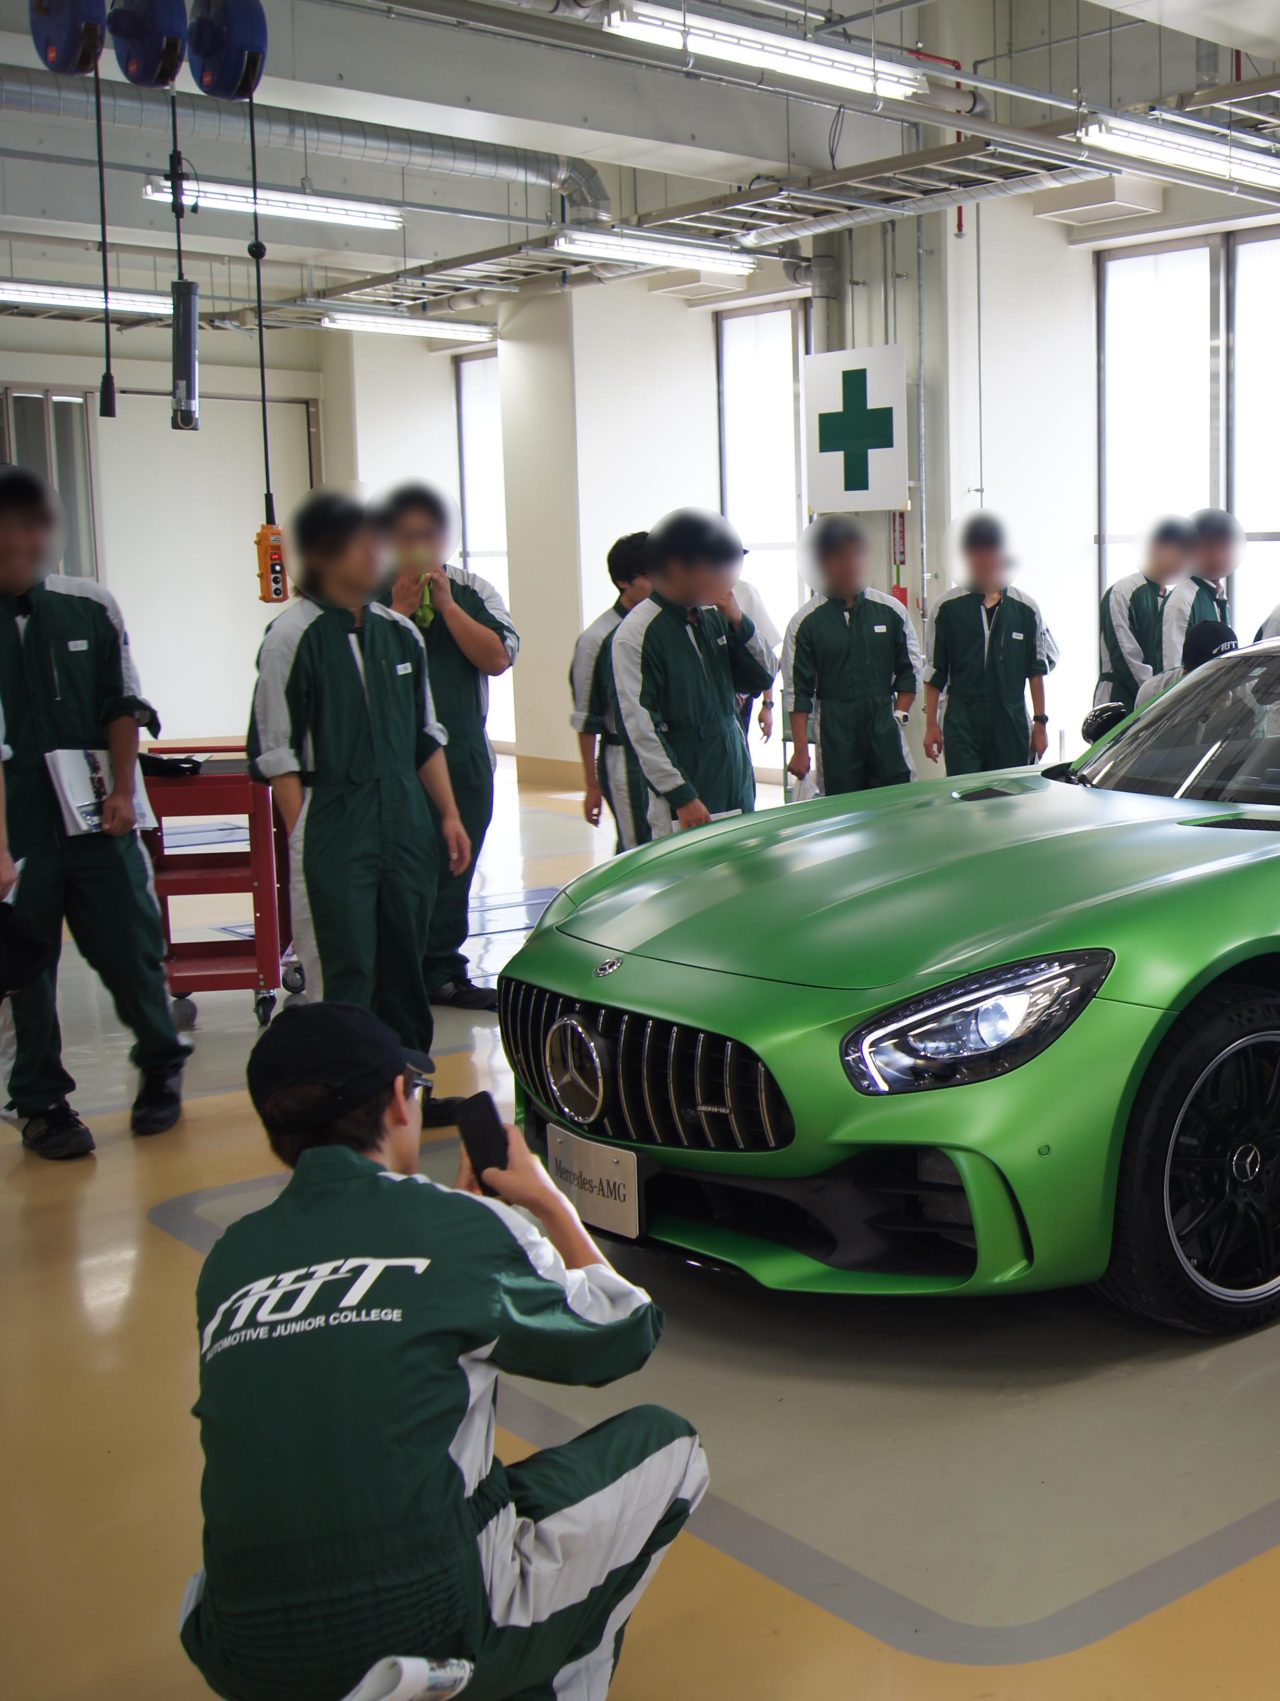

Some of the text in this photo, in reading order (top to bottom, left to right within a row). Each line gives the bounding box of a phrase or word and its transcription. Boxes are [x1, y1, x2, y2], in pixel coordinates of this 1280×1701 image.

[554, 1157, 627, 1203] Mercedes-AMG
[201, 1257, 432, 1355] AUT
[272, 1312, 326, 1338] JUNIOR
[328, 1308, 403, 1326] COLLEGE
